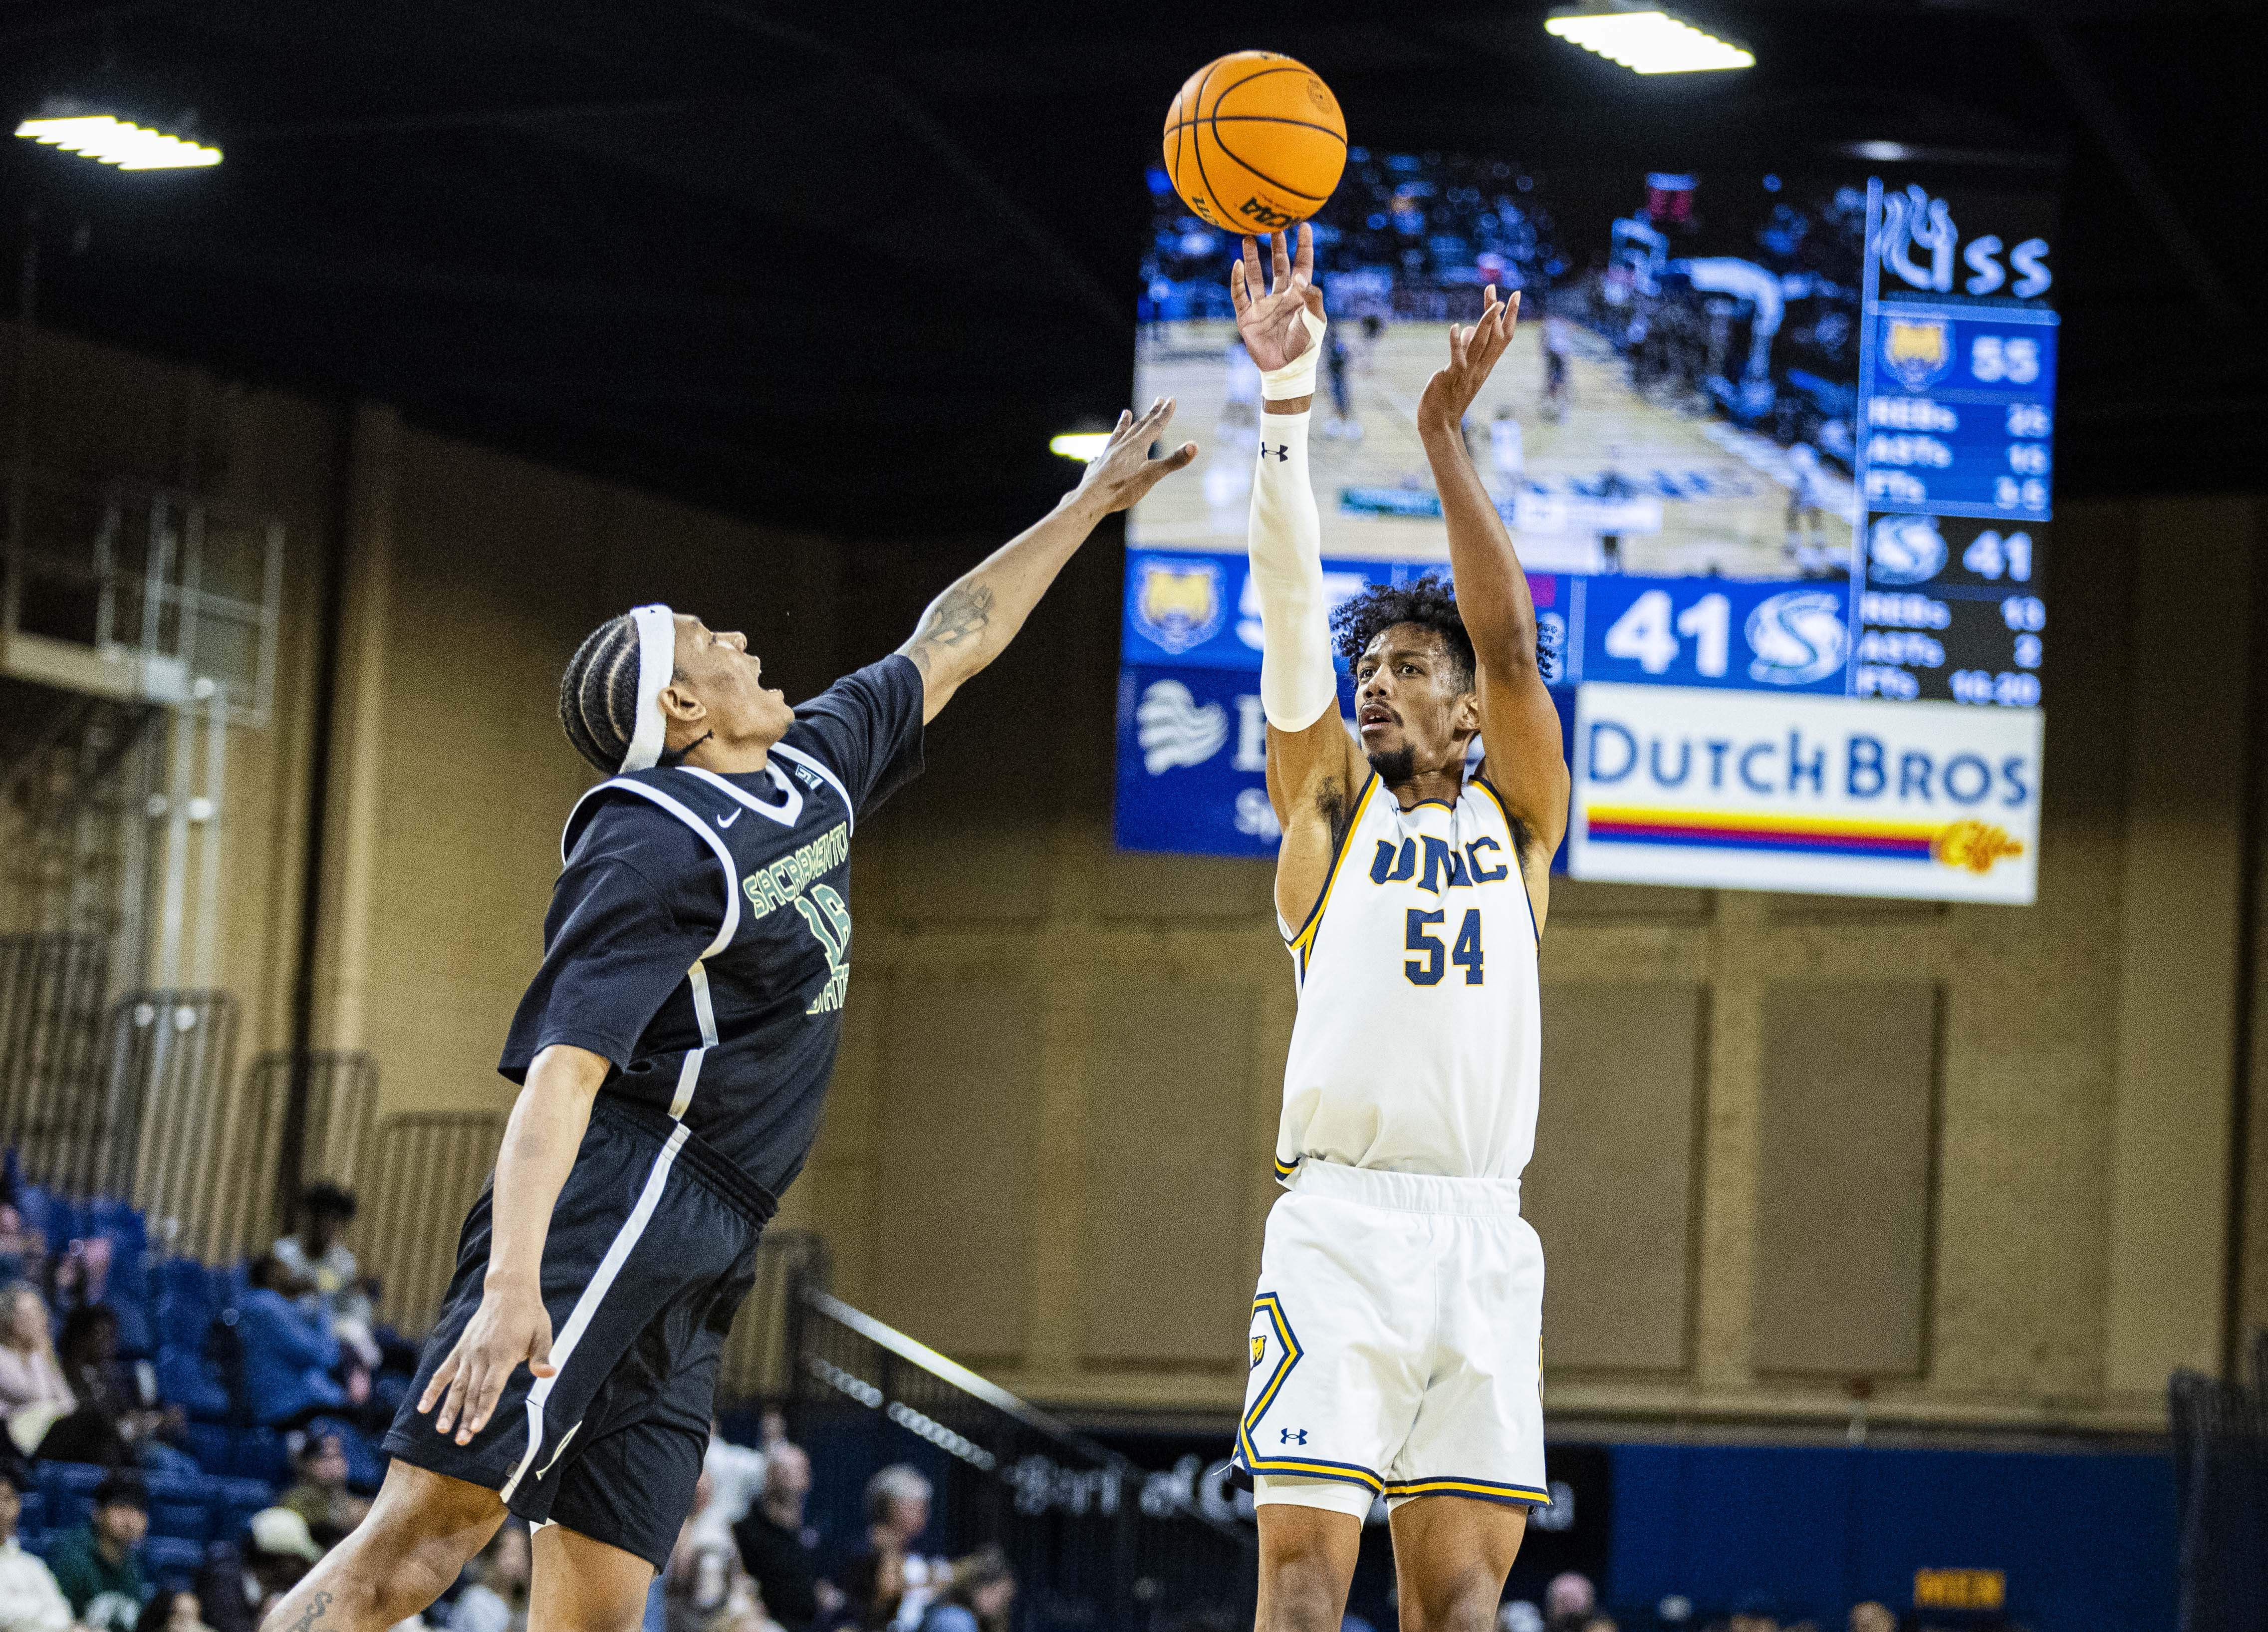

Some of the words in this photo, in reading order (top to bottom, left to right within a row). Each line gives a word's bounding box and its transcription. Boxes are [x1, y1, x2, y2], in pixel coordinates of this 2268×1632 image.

[1963, 531, 2031, 581] 41
[1604, 590, 1731, 678] 41
[743, 821, 848, 919] SACRAMENTO
[1368, 833, 1508, 897] UNC
[1403, 907, 1485, 987] 54
[806, 963, 849, 1015] ATE
